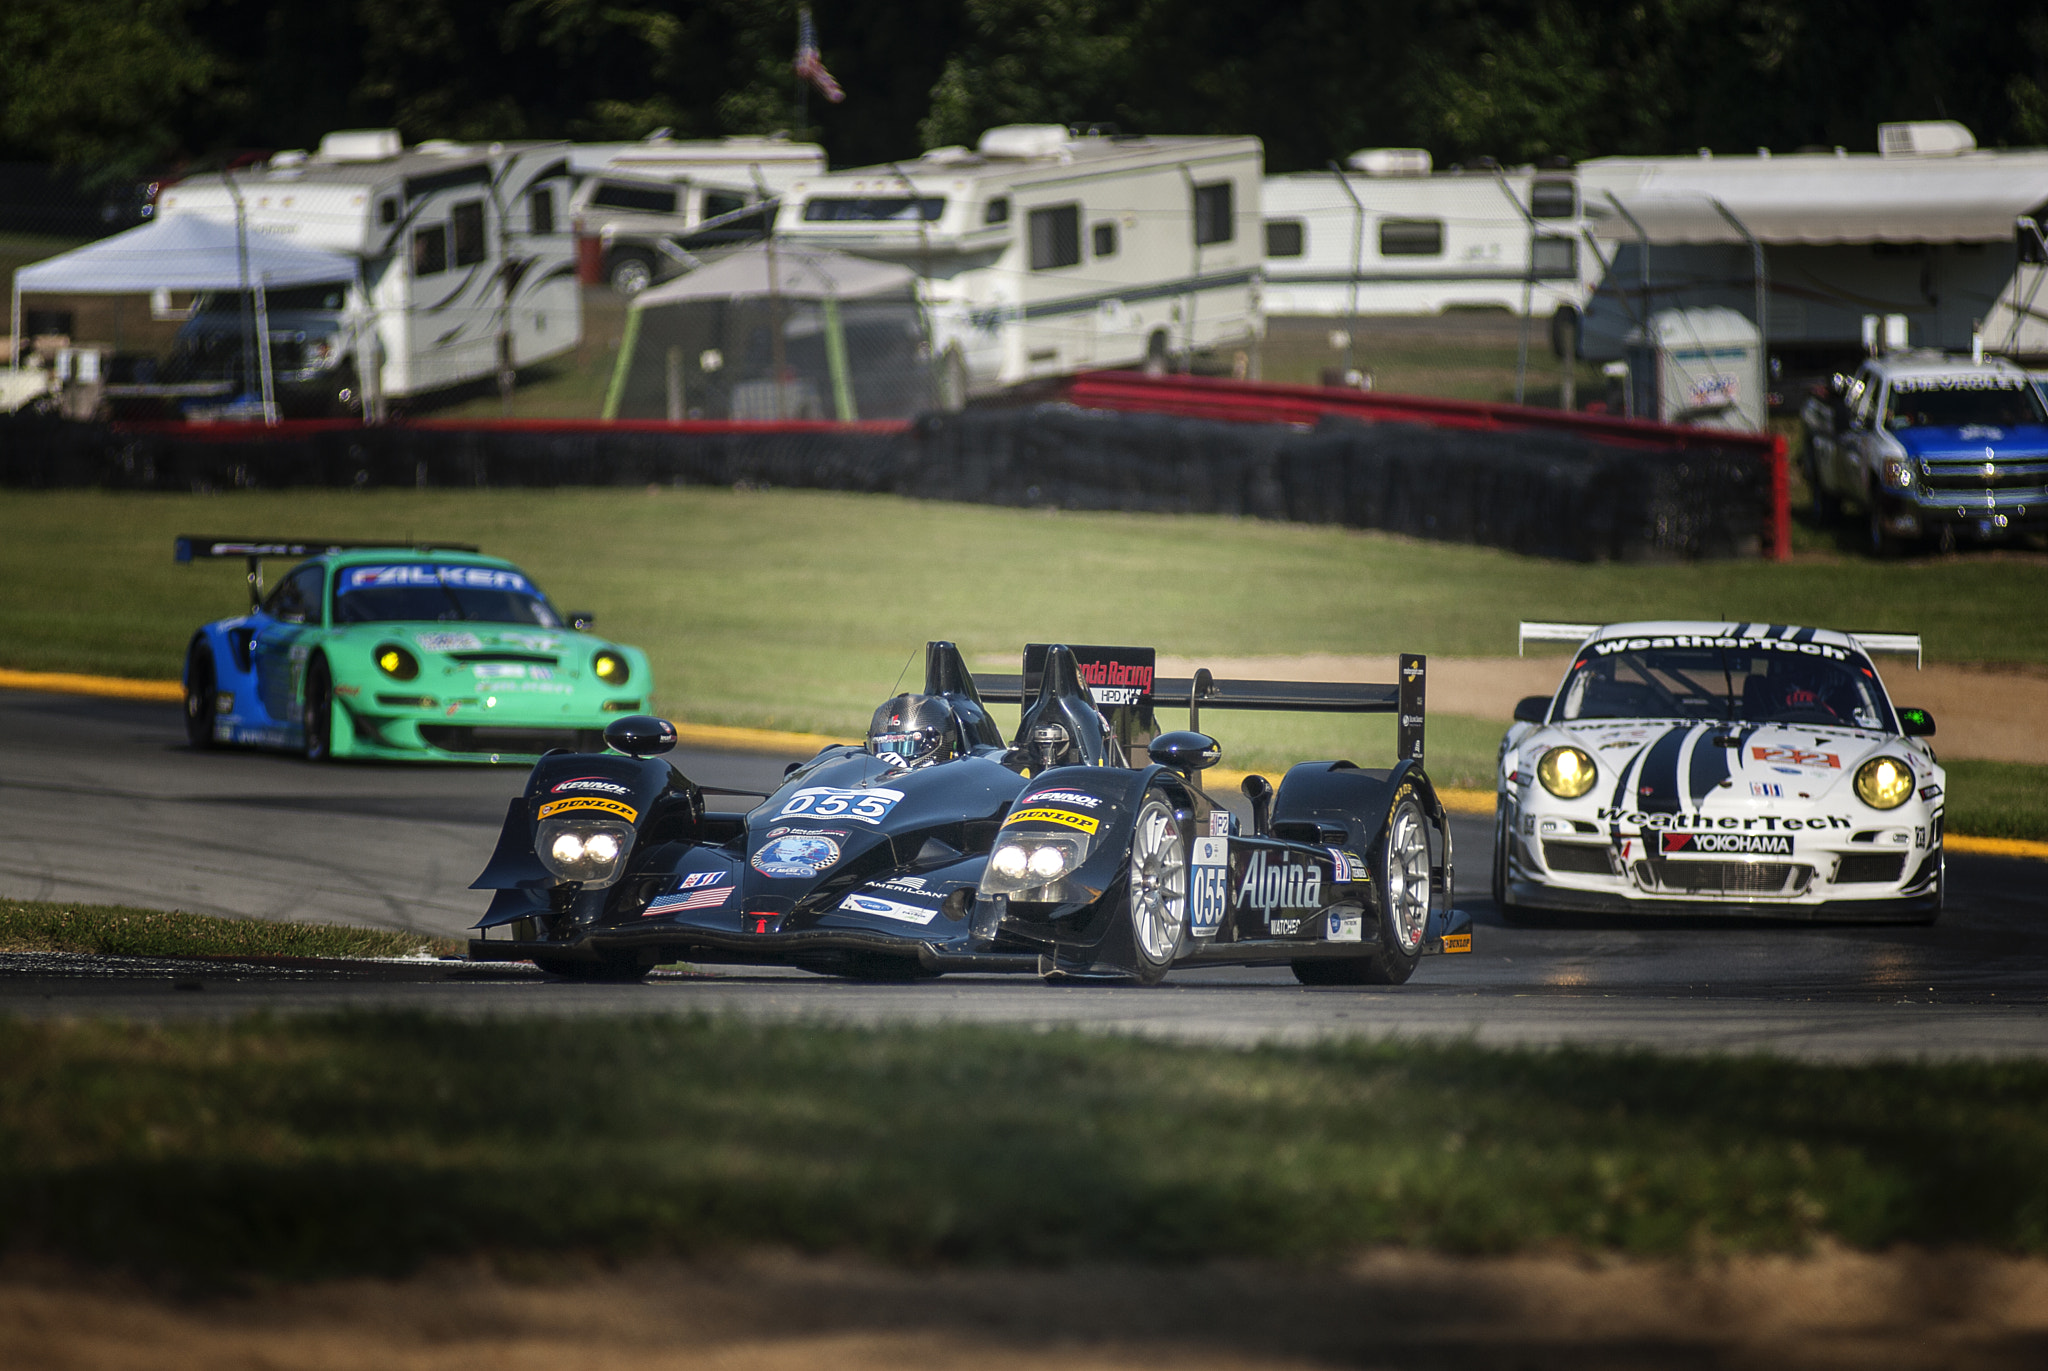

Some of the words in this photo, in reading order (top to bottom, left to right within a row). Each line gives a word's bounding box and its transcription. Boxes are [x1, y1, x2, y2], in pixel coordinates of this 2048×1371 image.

[352, 566, 525, 591] FALKEN
[1595, 636, 1846, 660] WeatherTech
[1107, 661, 1153, 695] Racing
[1101, 690, 1121, 702] HPD
[1764, 748, 1832, 768] 22
[555, 781, 627, 794] KENNOL
[553, 800, 633, 815] DUNLOP
[780, 795, 892, 817] 055
[1027, 792, 1100, 807] KENNOL
[1012, 811, 1093, 827] DUNLOP
[1597, 807, 1850, 831] WeatherTech
[1693, 835, 1790, 853] YOKOHAMA
[865, 881, 945, 898] AMERILOAN
[1193, 867, 1226, 925] 055
[1236, 850, 1322, 924] Alpina
[1270, 919, 1301, 935] WATCHES
